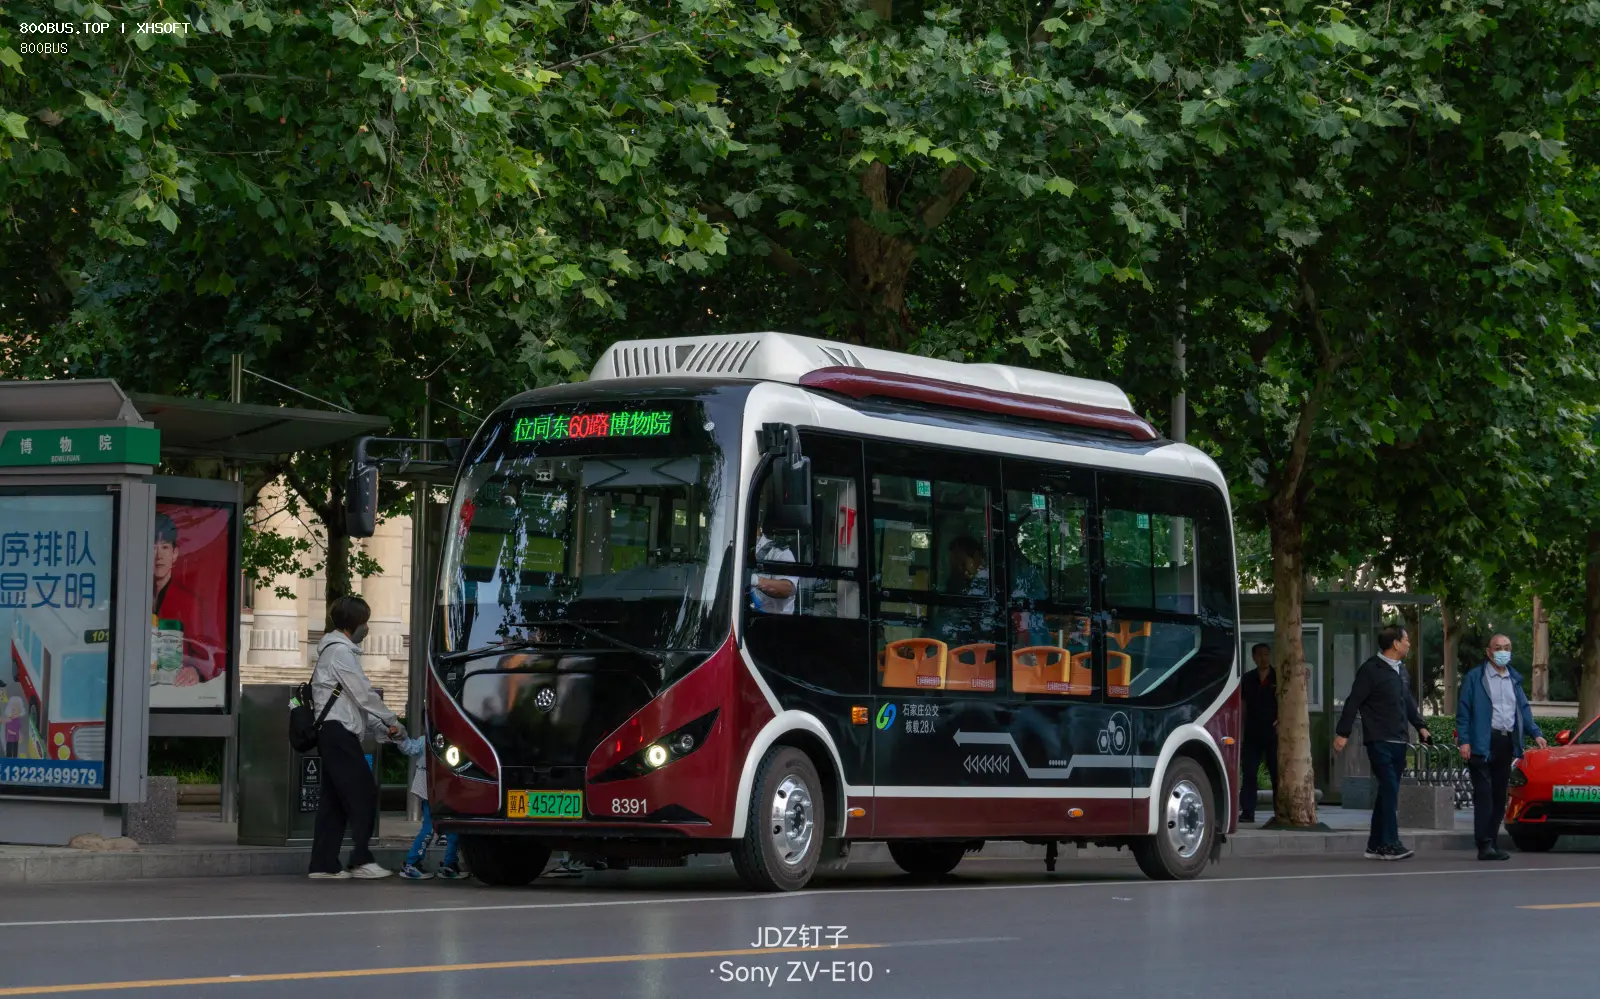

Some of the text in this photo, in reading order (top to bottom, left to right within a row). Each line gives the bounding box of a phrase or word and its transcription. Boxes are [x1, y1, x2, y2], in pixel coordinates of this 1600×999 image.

[20, 434, 112, 455] 博物院
[0, 530, 96, 567] 序排队
[0, 572, 96, 609] 显文明
[902, 703, 940, 717] 石家庄公交
[905, 719, 937, 734] 核载28人
[4, 766, 97, 785] 13223499979
[611, 798, 648, 814] 8391
